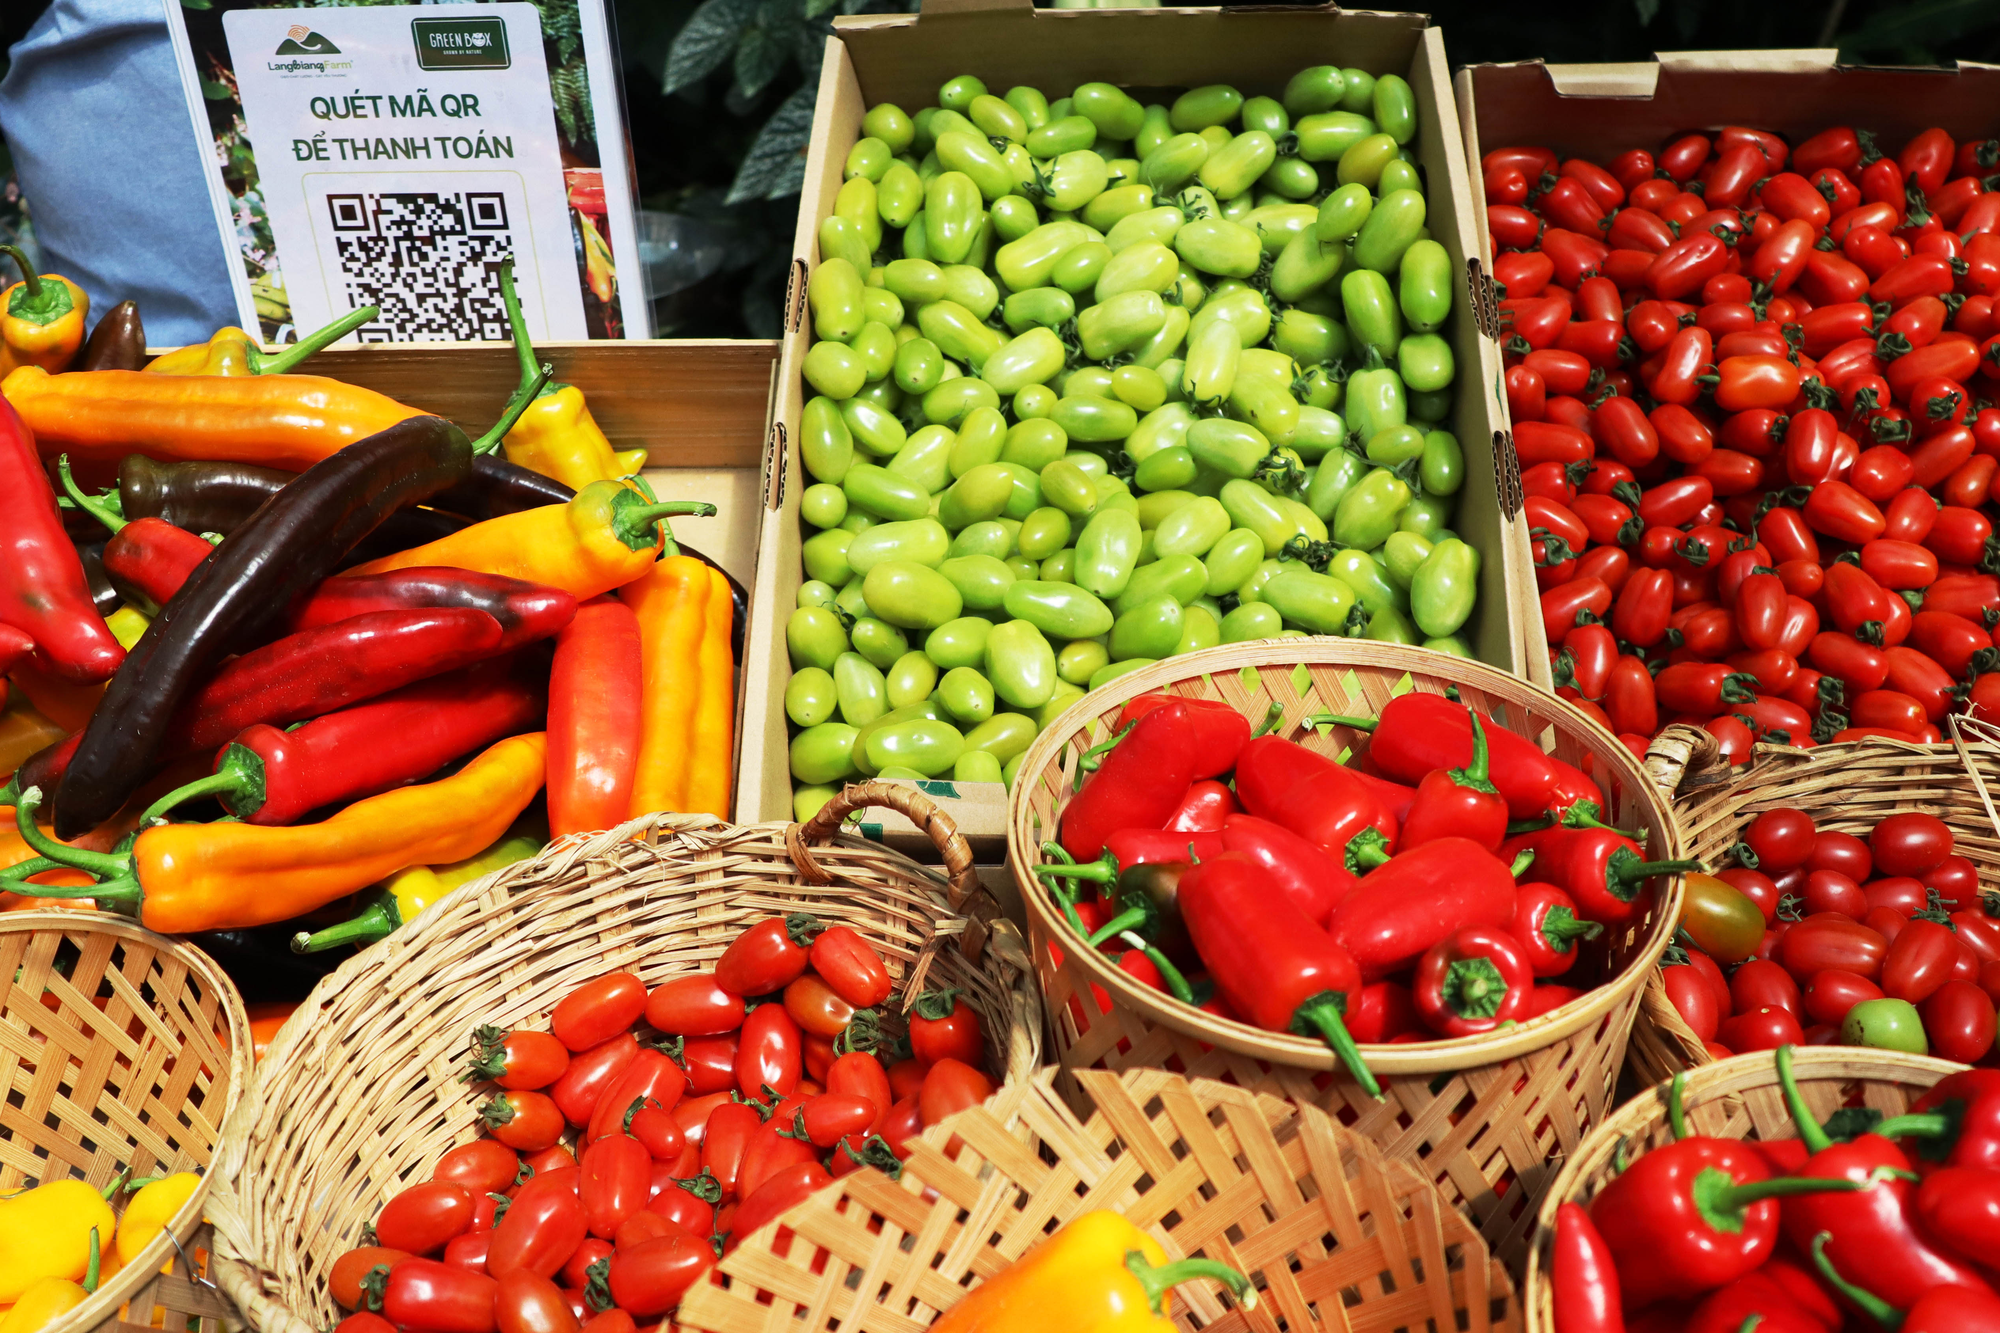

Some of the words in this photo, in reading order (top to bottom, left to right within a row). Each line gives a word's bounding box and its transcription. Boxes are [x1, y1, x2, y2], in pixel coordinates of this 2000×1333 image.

[429, 33, 462, 47] GREEN
[310, 88, 382, 120] QUÉT
[389, 88, 436, 118] MÃ
[440, 94, 481, 119] QR
[292, 130, 330, 161] ĐỂ
[332, 137, 431, 160] THANH
[434, 129, 514, 159] TOÁN
